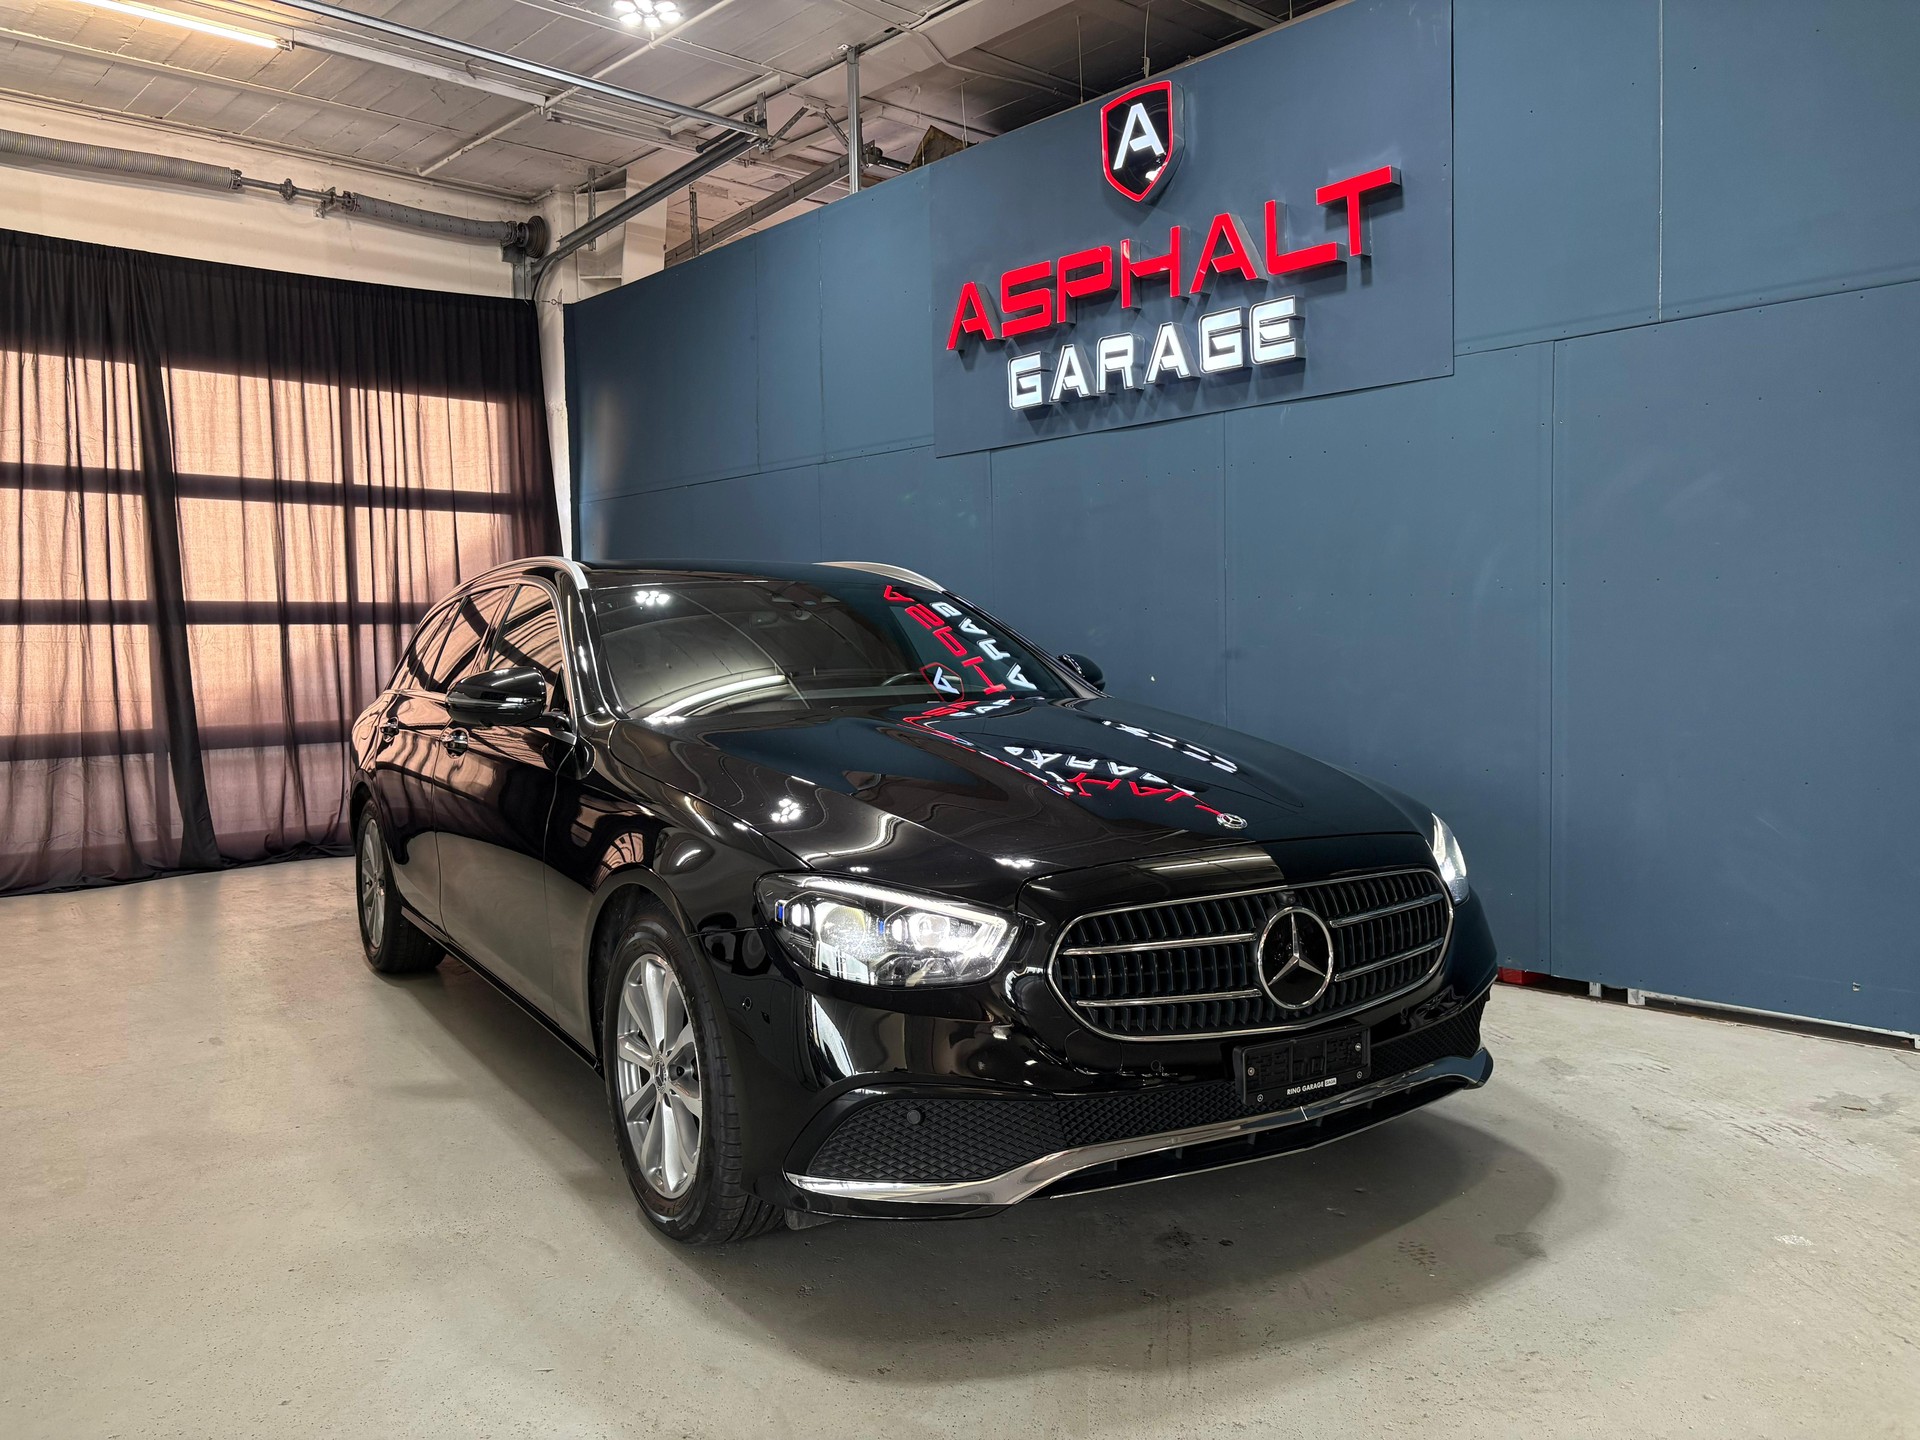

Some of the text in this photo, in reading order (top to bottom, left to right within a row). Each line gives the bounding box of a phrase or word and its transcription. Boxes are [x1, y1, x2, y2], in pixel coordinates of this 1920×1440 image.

[1113, 102, 1165, 170] A
[946, 165, 1396, 351] ASPHALT
[1007, 295, 1300, 411] GARAGE
[1287, 1087, 1301, 1095] RING
[1302, 1081, 1324, 1092] GARAGE
